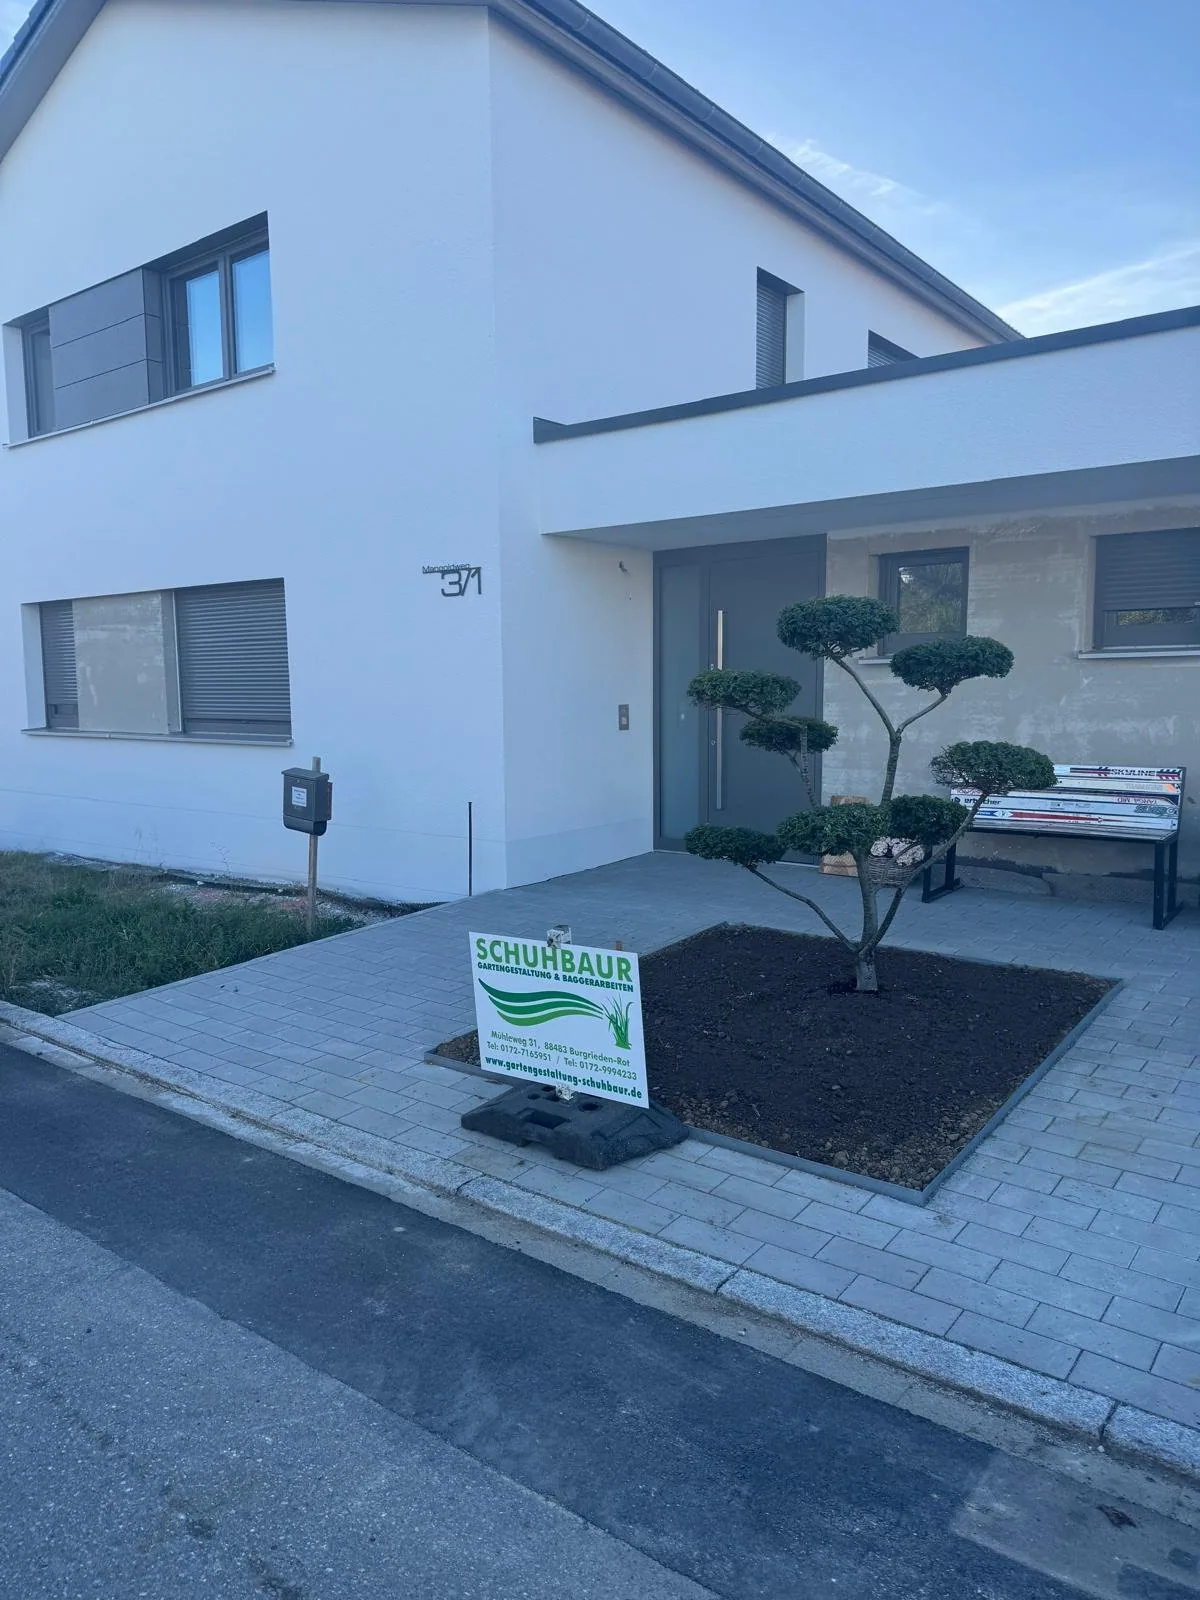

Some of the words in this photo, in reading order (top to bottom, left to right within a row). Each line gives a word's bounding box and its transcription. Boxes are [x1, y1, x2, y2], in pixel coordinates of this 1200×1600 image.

[1110, 768, 1155, 777] SKYLINE
[476, 937, 633, 982] SCHUHBAUR
[477, 962, 551, 979] GARTENGESTALTUNG
[562, 974, 634, 992] BAGGERARBEITEN
[487, 1041, 499, 1050] Tel:
[500, 1044, 551, 1061] 0172-7165951
[564, 1057, 578, 1067] Tel:
[580, 1061, 637, 1080] 0172-9994233
[491, 1030, 527, 1047] Mühleweg
[528, 1038, 541, 1049] 31,
[544, 1042, 568, 1053] 88483
[569, 1047, 630, 1067] Burgrieden-Rot
[485, 1056, 642, 1098] www.gartengestaltung-schuhbaur.de
